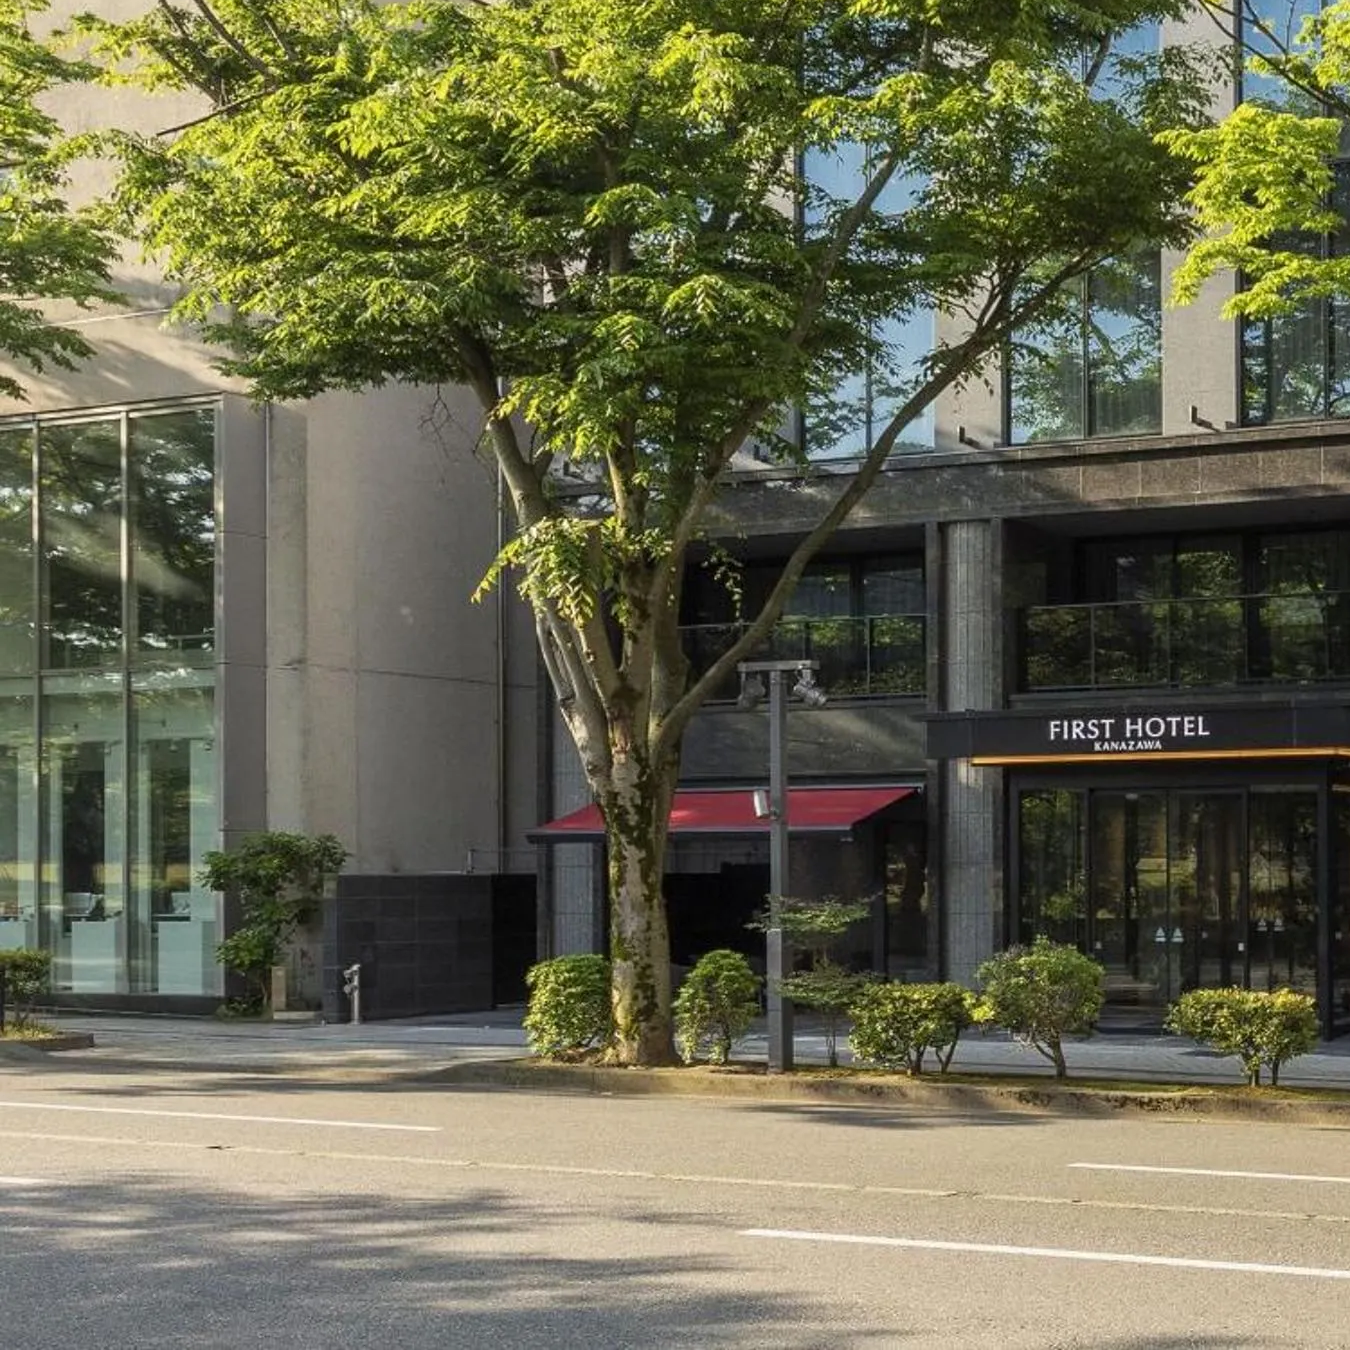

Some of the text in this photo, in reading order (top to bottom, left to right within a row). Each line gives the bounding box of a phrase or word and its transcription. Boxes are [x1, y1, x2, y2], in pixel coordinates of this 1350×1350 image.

[1050, 716, 1210, 740] FIRST HOTEL
[1094, 740, 1162, 751] KANAZAWA
